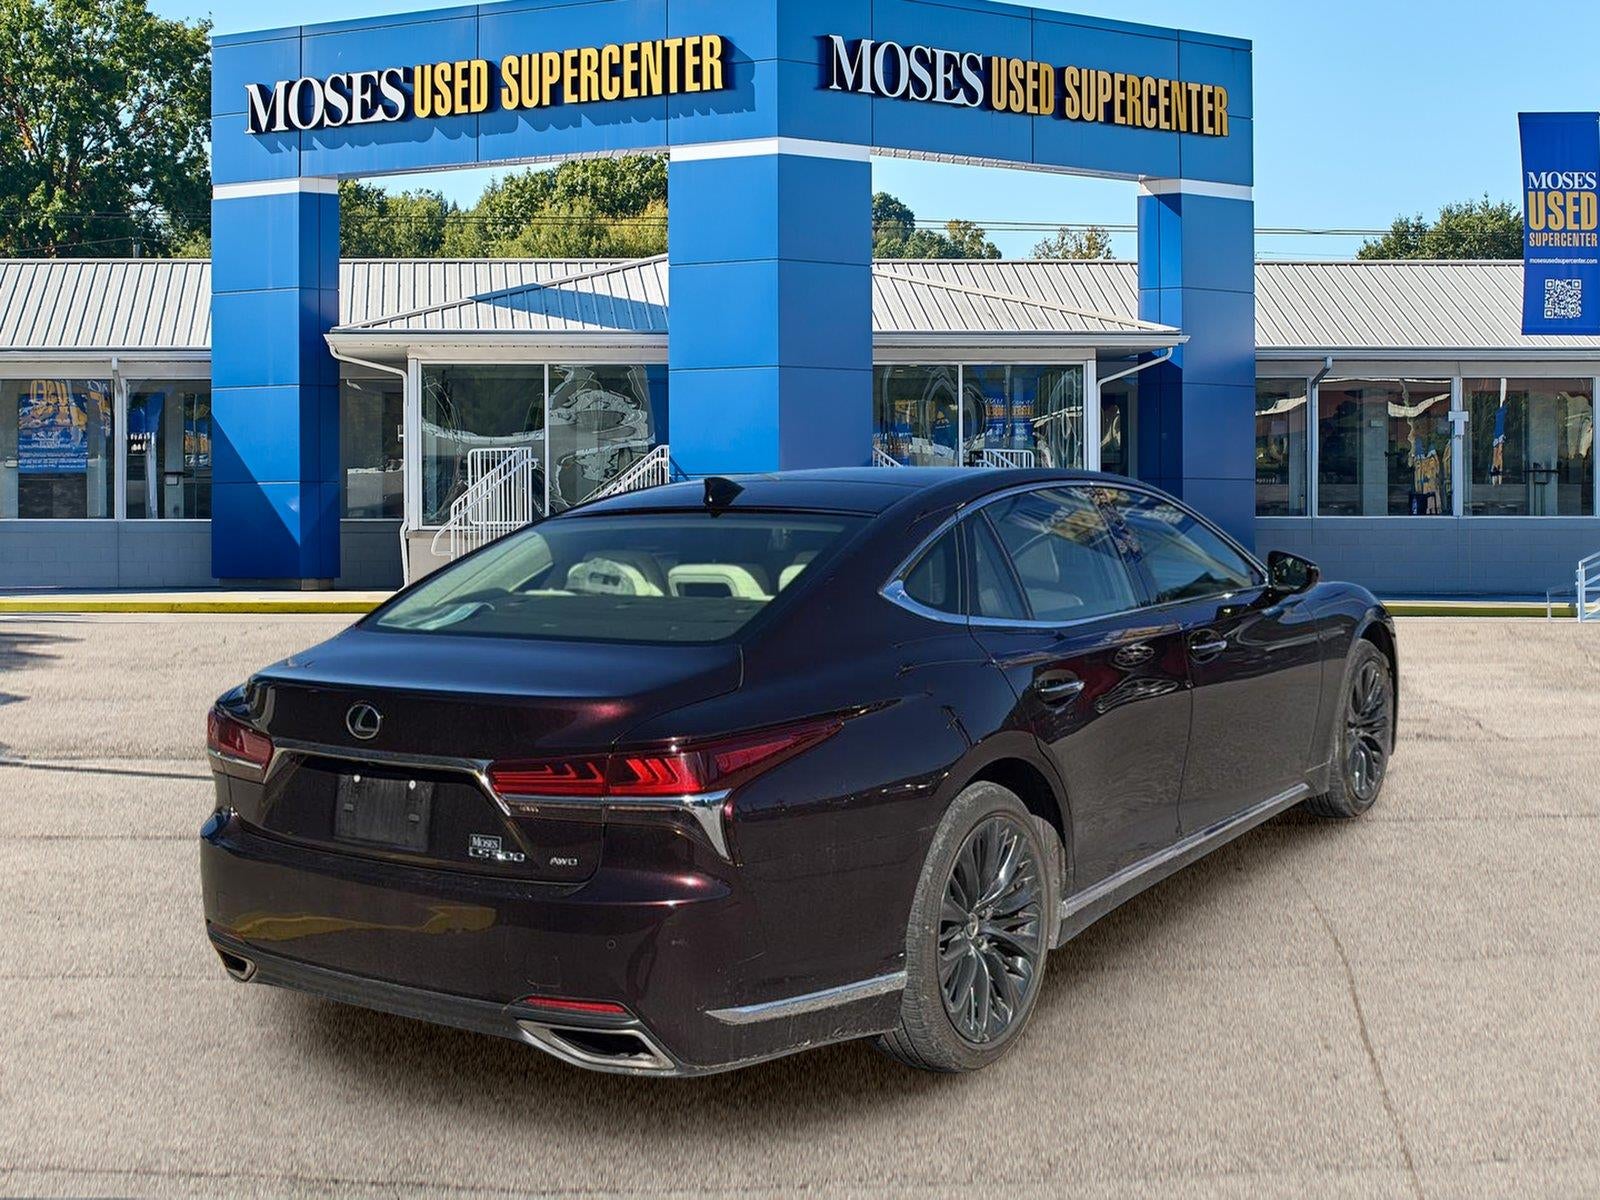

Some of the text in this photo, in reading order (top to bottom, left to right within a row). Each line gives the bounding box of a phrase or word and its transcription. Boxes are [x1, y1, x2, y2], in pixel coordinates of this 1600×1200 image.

[245, 34, 723, 134] MOSES USED SUPERCENTER
[828, 34, 1230, 137] MOSES USED SUPERCENTER
[1527, 171, 1597, 190] MOSES
[1528, 191, 1597, 230] USED
[1529, 232, 1598, 247] SUPERCENTER
[549, 856, 578, 866] AWD
